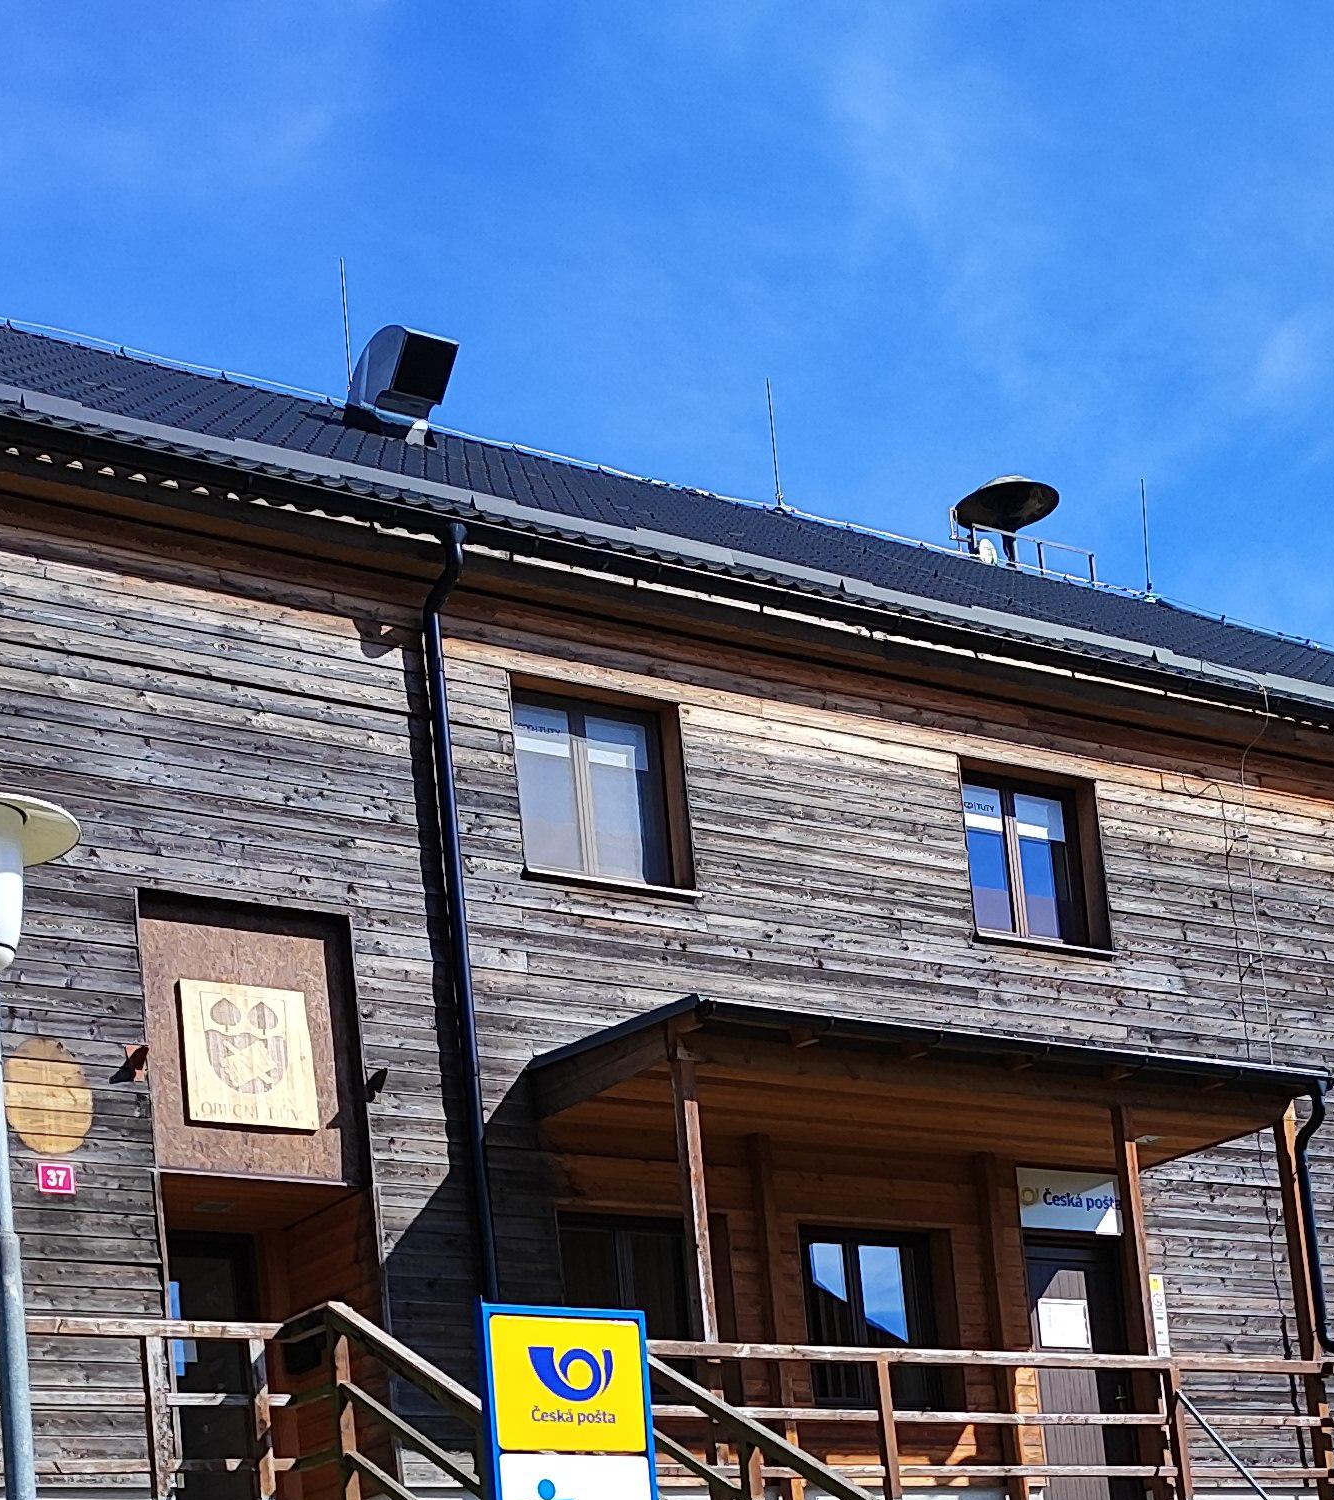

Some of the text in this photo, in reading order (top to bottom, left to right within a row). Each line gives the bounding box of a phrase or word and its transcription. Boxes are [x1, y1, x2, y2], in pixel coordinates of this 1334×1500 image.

[47, 1169, 67, 1187] 37
[1042, 1187, 1123, 1212] Česká pošta
[531, 1405, 617, 1426] Česká pošta
